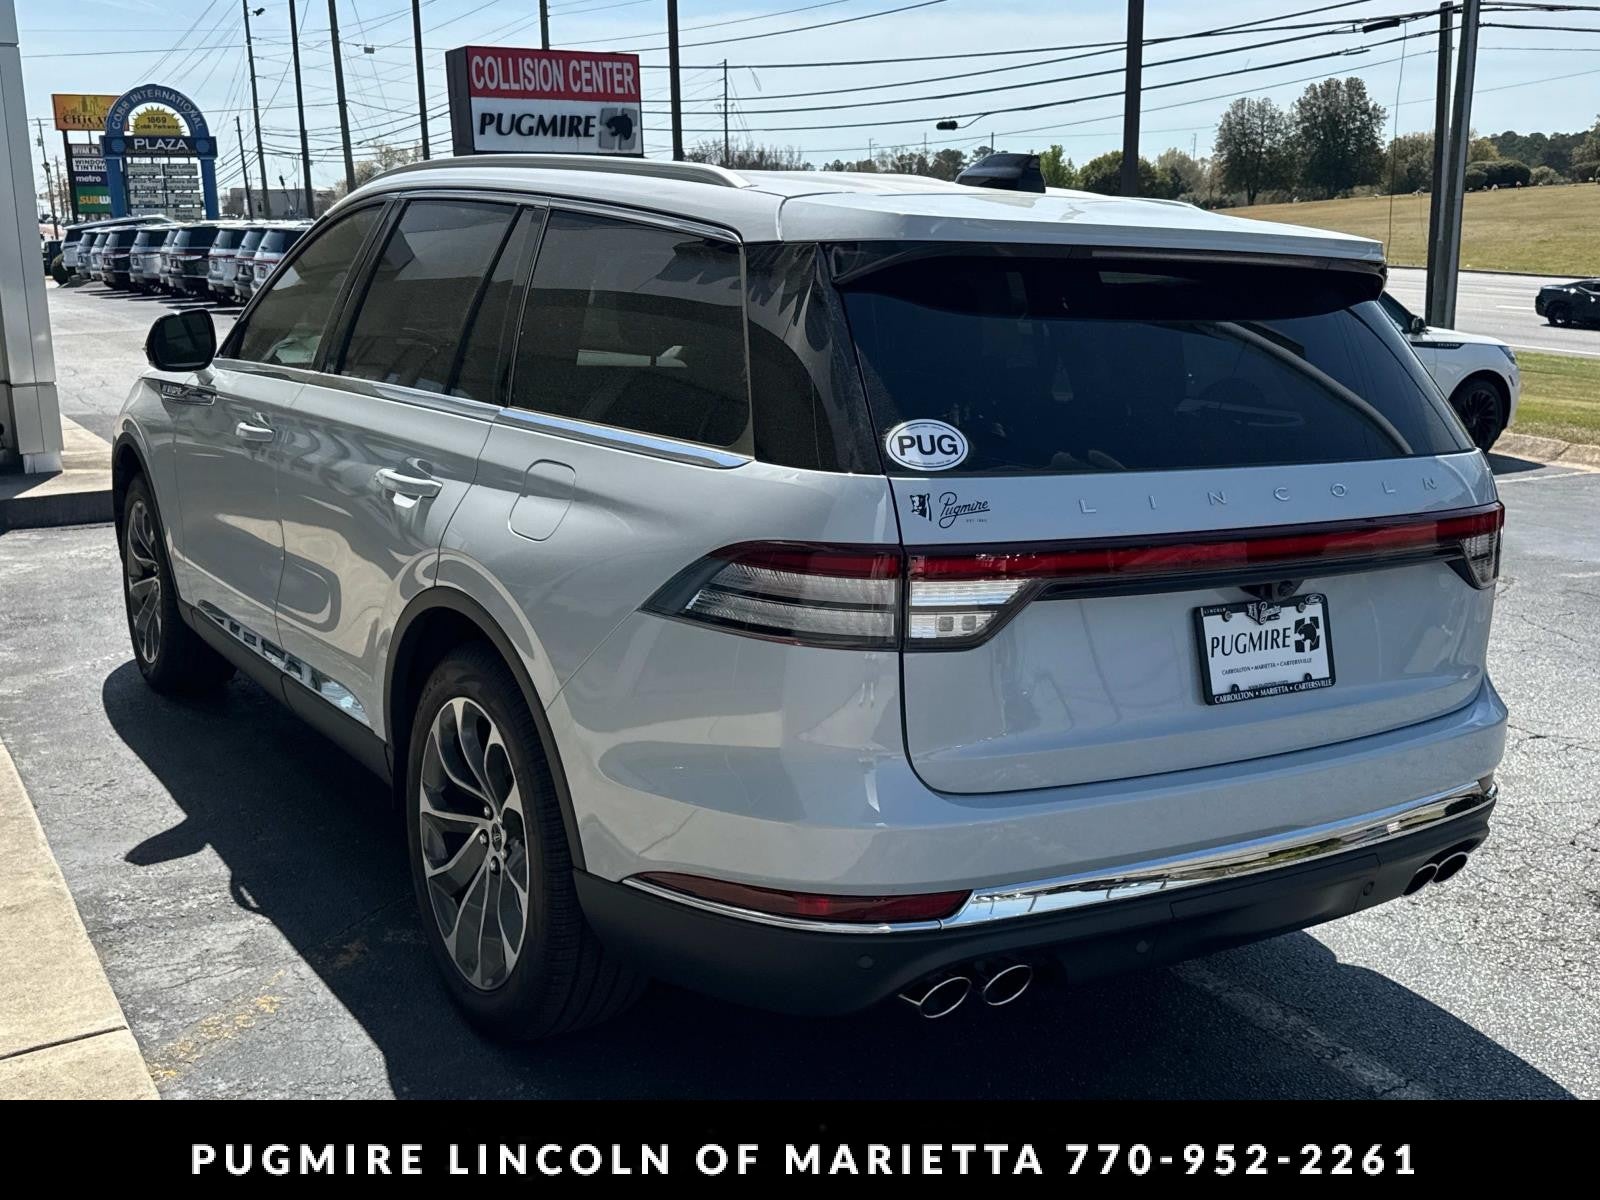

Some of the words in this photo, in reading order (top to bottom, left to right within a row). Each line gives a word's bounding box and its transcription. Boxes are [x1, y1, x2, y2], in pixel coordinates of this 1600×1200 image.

[471, 55, 565, 92] COLLISION
[568, 59, 636, 94] CENTER
[63, 115, 107, 124] CHICA
[112, 101, 129, 129] COBB
[130, 89, 203, 130] INTERNATIONAL
[479, 112, 596, 137] PUGMIRE
[134, 138, 188, 150] PLAZA
[80, 195, 112, 204] SUBW
[897, 434, 959, 456] PUG
[1078, 477, 1438, 513] LINCOLN
[938, 491, 991, 529] Pugmire
[1210, 627, 1291, 658] PUGMIRE
[1253, 662, 1276, 671] MARIETTA
[1279, 657, 1312, 667] CARTERSVILLE
[1214, 691, 1254, 704] CARROLLTON
[1260, 685, 1289, 696] MARIETTA
[1294, 679, 1332, 691] CARTERSVILLE
